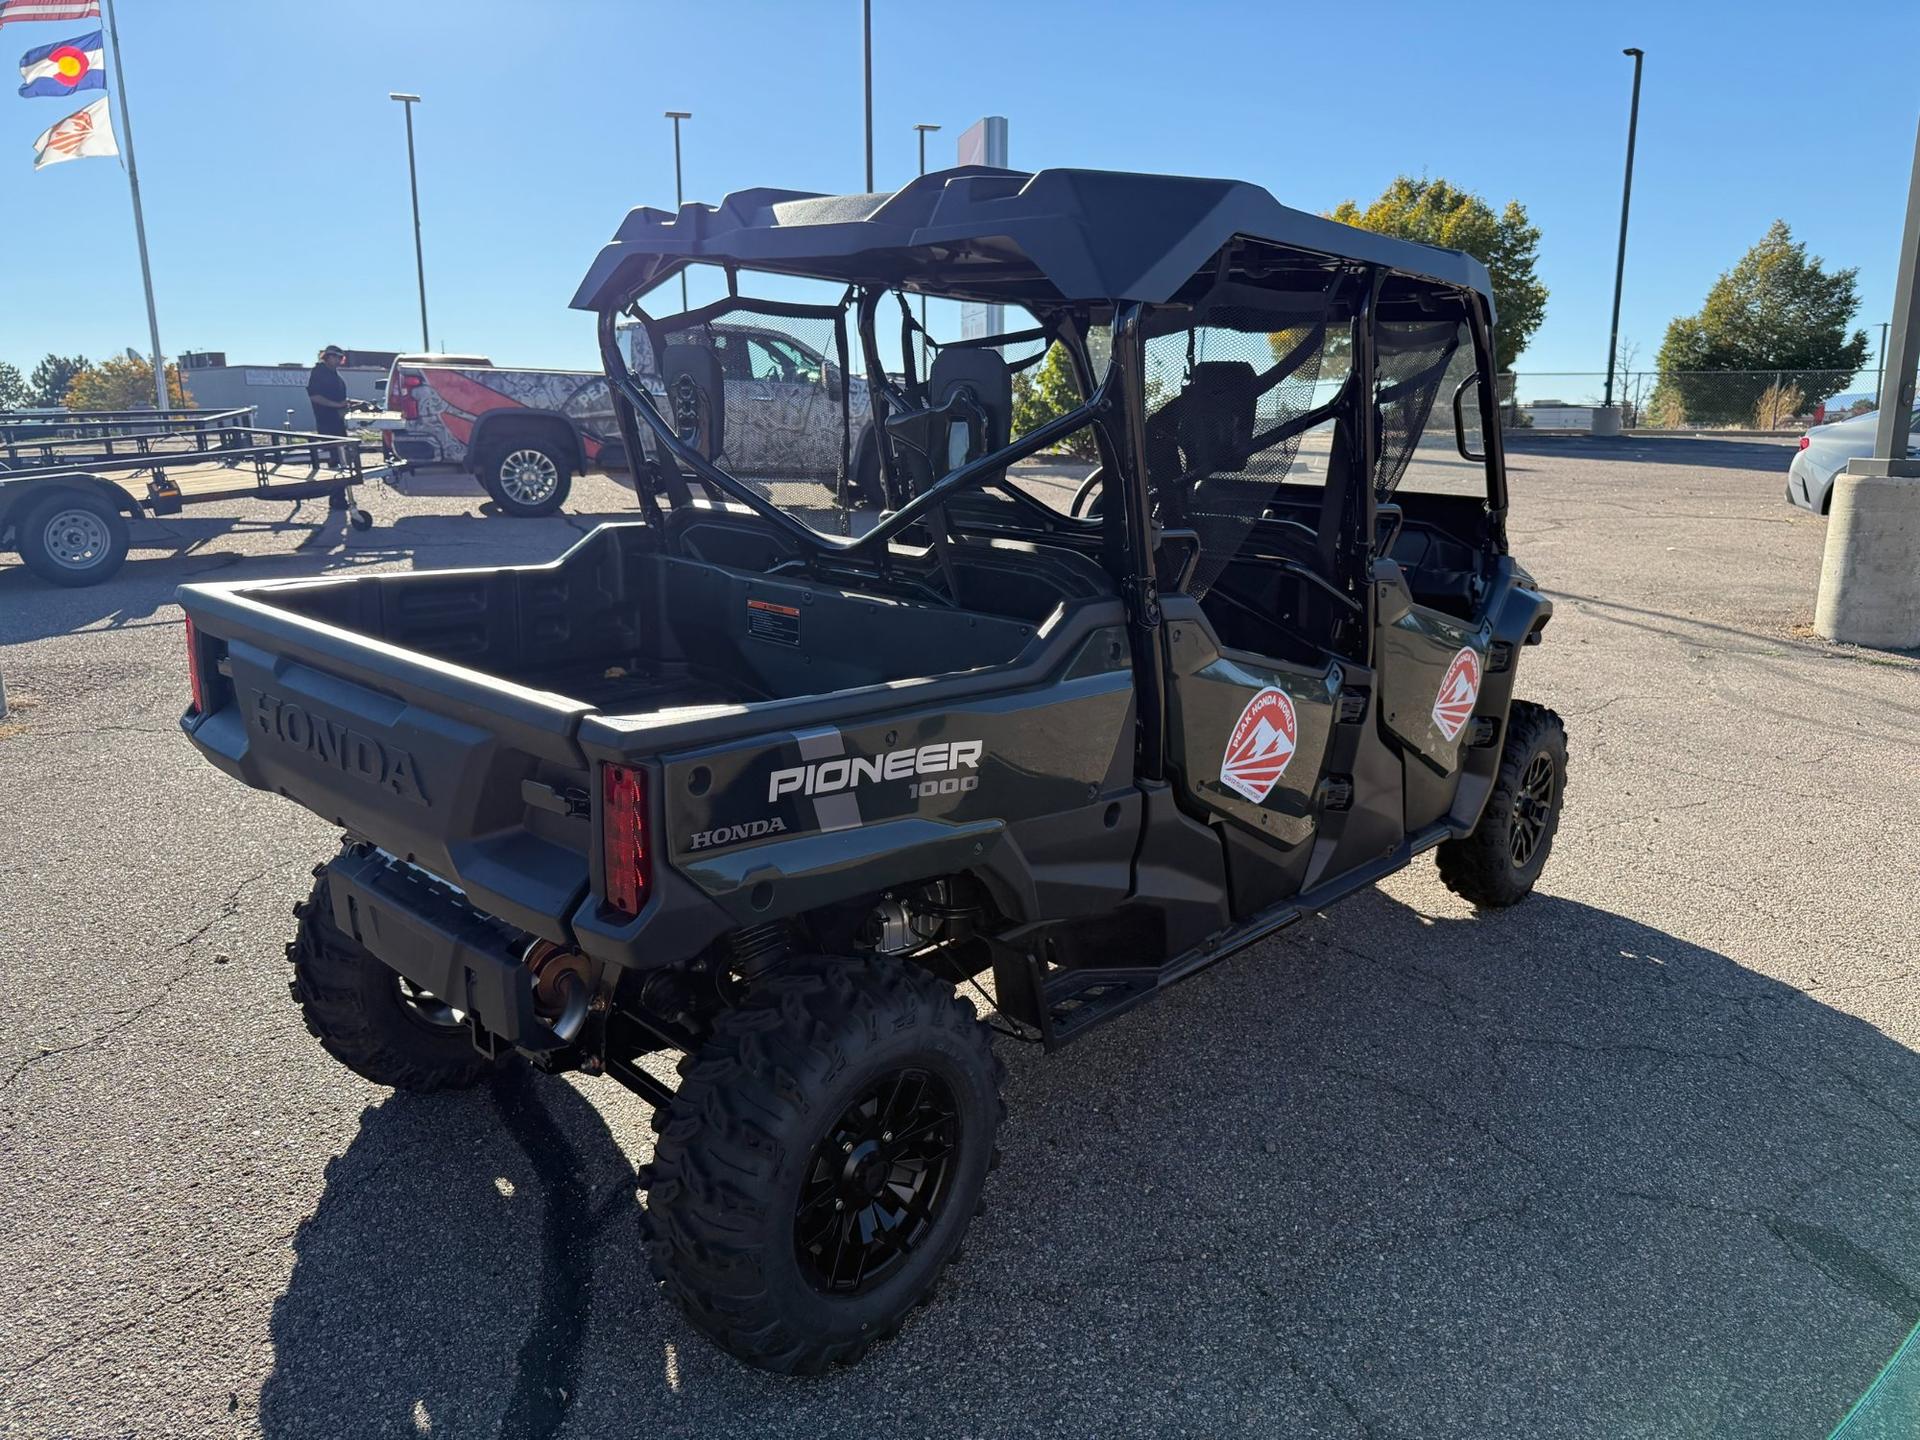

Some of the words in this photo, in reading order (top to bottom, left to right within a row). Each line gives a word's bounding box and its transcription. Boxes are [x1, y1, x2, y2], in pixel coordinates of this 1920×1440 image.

[576, 379, 610, 408] PEA
[1232, 712, 1252, 748] PEAK
[1251, 695, 1277, 716] HONDA
[1278, 697, 1293, 733] WORLD
[251, 688, 432, 807] HONDA
[768, 740, 983, 803] PIONEER
[909, 776, 979, 799] 1000
[690, 817, 787, 850] HONDA
